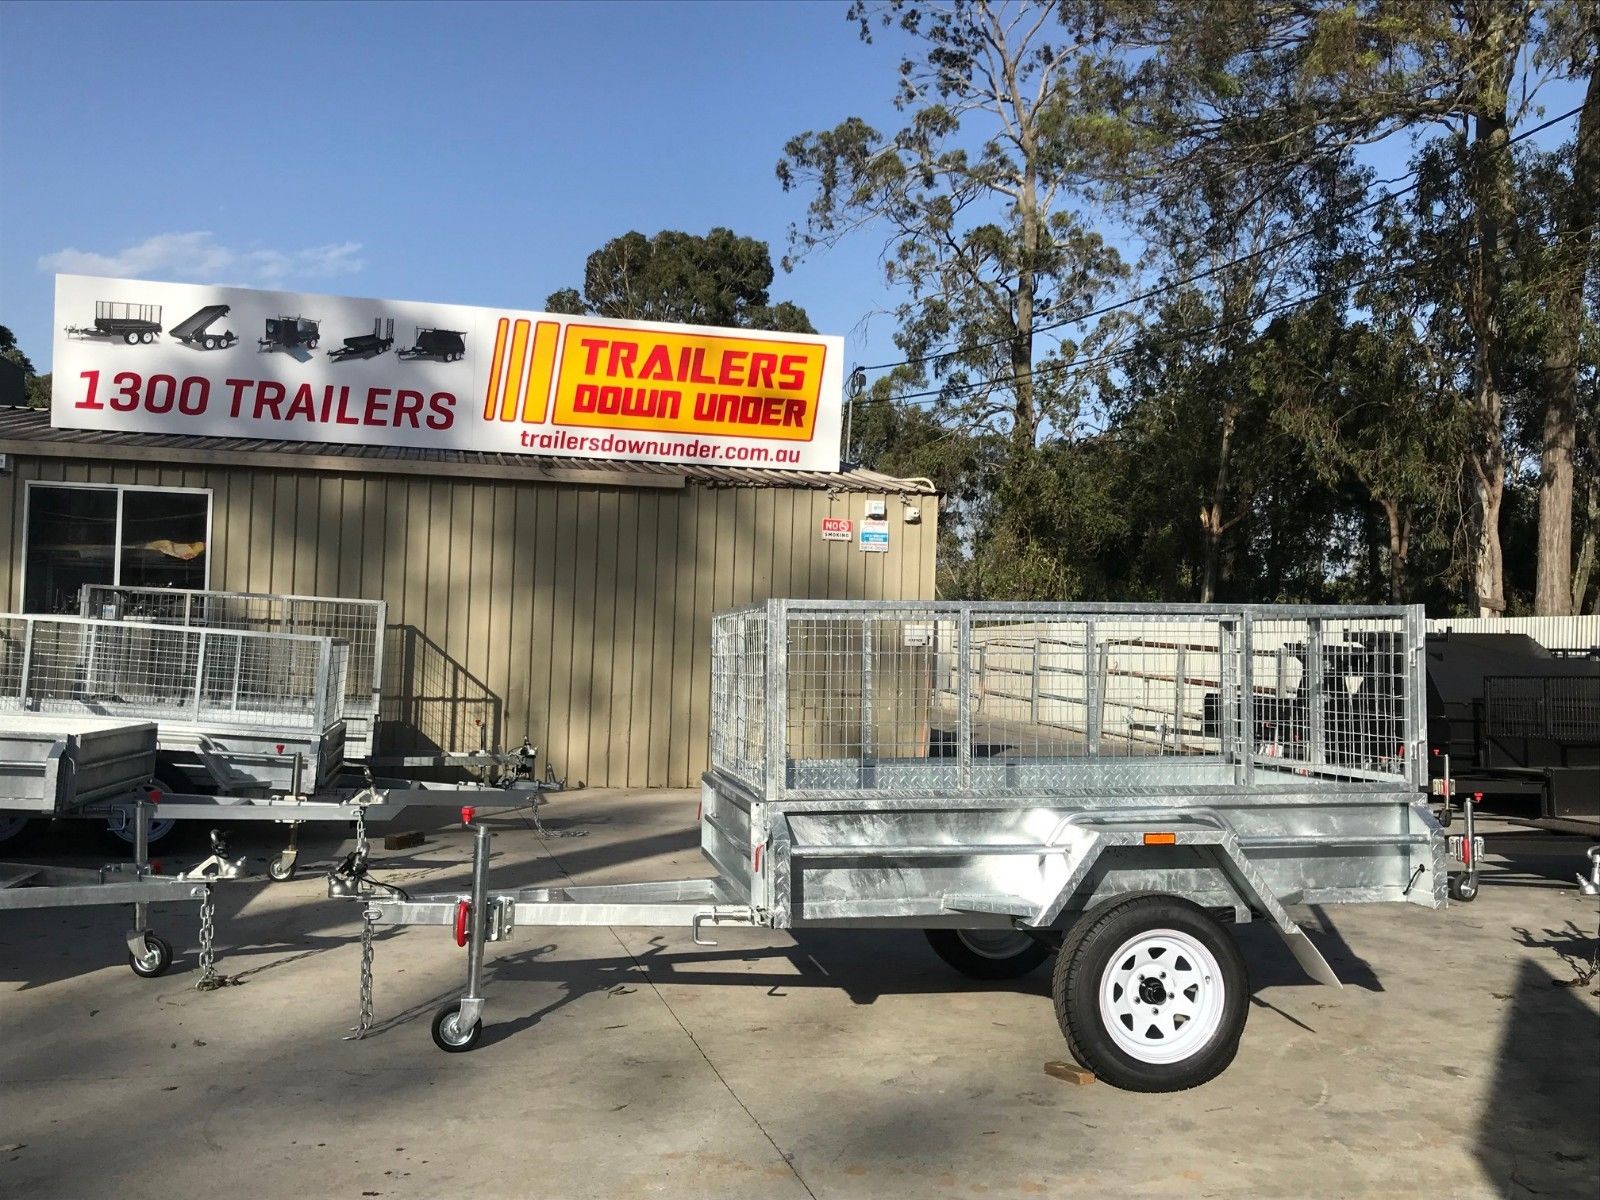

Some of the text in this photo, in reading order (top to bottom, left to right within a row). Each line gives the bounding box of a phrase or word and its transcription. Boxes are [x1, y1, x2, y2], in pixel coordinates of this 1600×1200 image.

[580, 338, 808, 391] TRAILERS
[74, 369, 457, 431] 1300 TRAILERS
[573, 384, 807, 428] DOWN UNDER
[520, 430, 800, 464] trailersdownunder.com.au
[825, 521, 838, 531] NO
